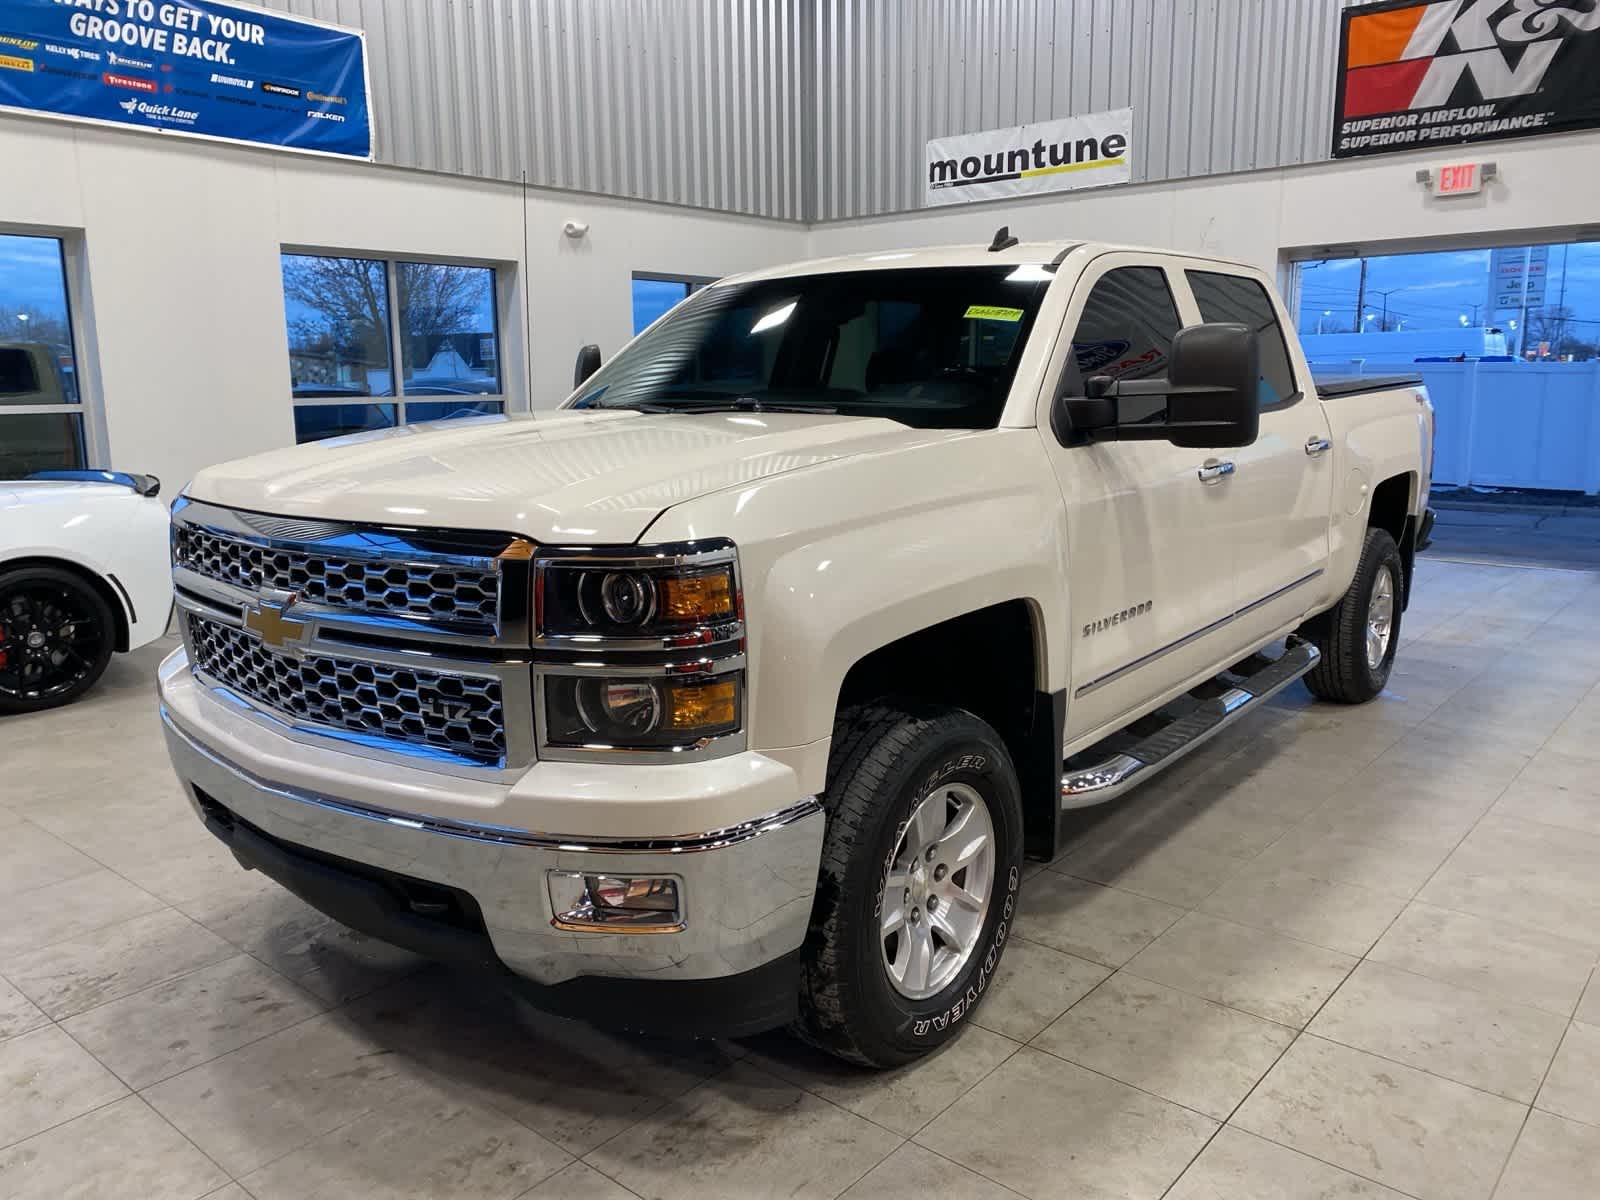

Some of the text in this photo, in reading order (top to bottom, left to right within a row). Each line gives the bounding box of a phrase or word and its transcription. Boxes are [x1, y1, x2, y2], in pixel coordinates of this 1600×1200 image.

[126, 0, 154, 21] TO
[159, 4, 202, 31] GET
[208, 14, 265, 45] YOUR
[70, 12, 235, 65] GROOVE BACK.
[117, 57, 153, 69] MICHELIN
[137, 101, 199, 120] Quick Lane
[307, 110, 345, 123] FALKEN
[1341, 103, 1497, 135] SUPERIOR AIRFLOW.
[1339, 129, 1418, 150] SUPERIOR
[929, 133, 1127, 183] mountune
[1439, 164, 1476, 192] EXIT
[1506, 280, 1535, 290] Jep
[1082, 600, 1153, 638] SILVERADO
[913, 865, 1019, 1036] GOODYEAR
